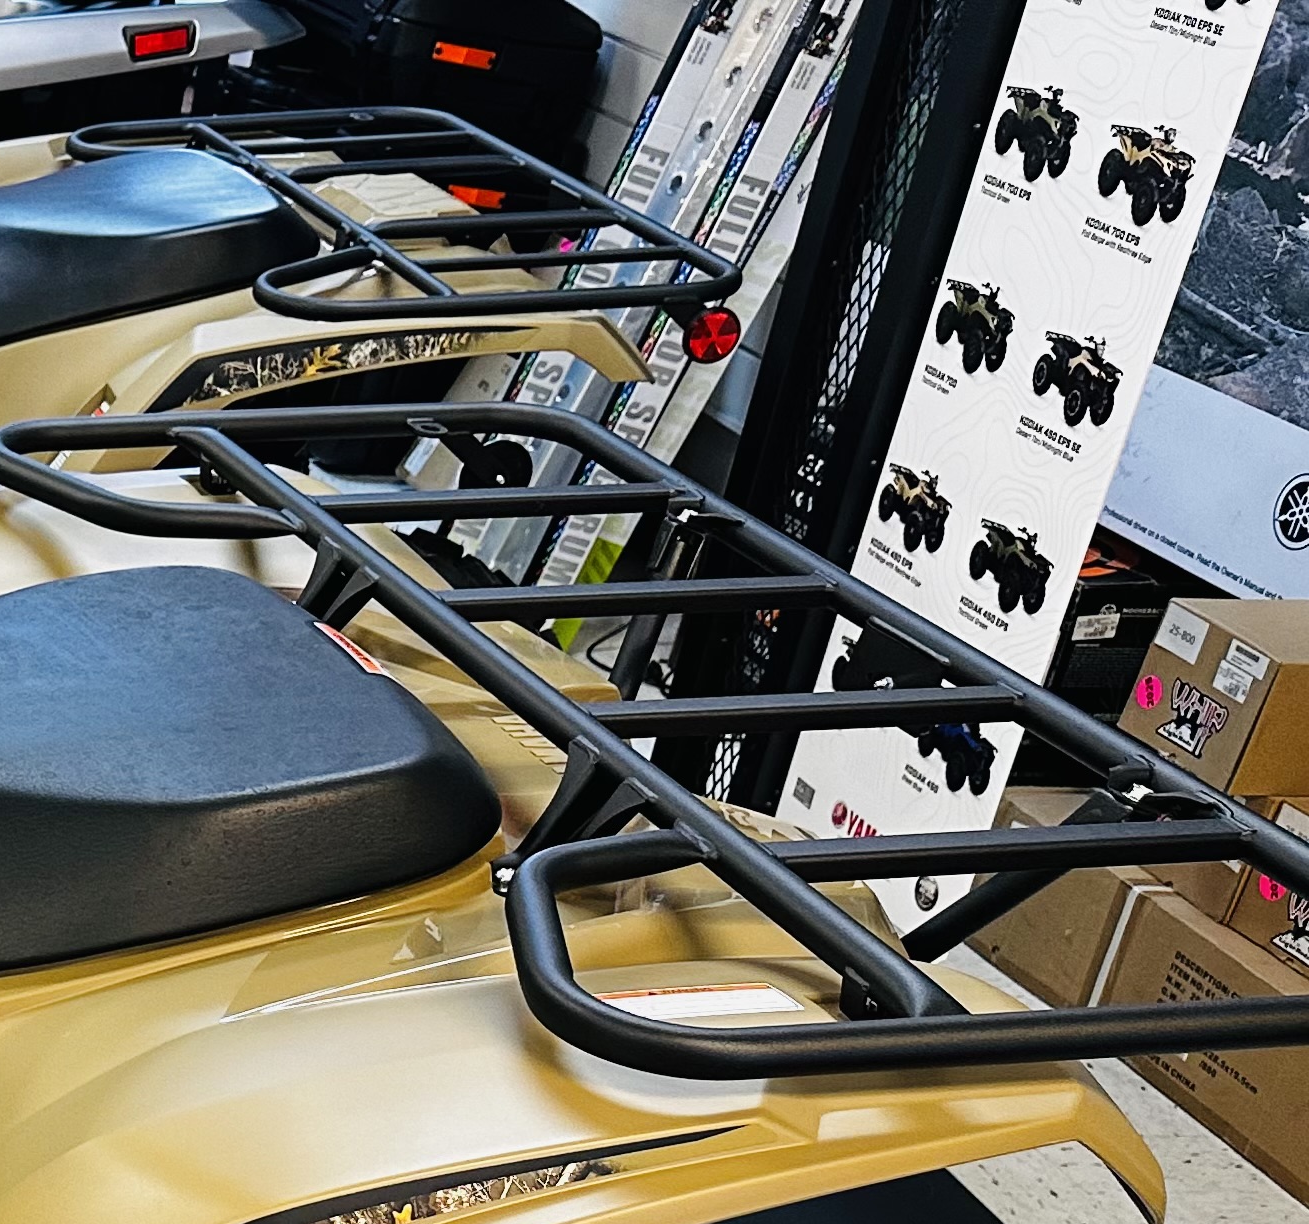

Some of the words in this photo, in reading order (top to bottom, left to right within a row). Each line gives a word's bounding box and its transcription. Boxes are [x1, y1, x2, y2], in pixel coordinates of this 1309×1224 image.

[1154, 7, 1181, 23] KODIAK
[1182, 15, 1197, 28] 700
[1198, 19, 1213, 33] EPS
[1213, 24, 1225, 36] SE
[618, 144, 671, 206] FUL
[984, 174, 1005, 190] KODIAK
[1005, 182, 1019, 196] 700
[1019, 187, 1032, 201] EPS
[708, 174, 771, 255] FULL
[1085, 216, 1110, 235] KODIAK
[1110, 227, 1126, 240] 700
[1126, 233, 1141, 246] EPS
[925, 364, 946, 382] KODIAK
[946, 375, 958, 388] 700
[1020, 415, 1044, 433] KODIAK
[1044, 428, 1057, 441] 450
[1057, 434, 1071, 449] EPS
[1103, 505, 1133, 526] Professional
[1133, 520, 1148, 534] driver
[1147, 529, 1155, 538] on
[1160, 535, 1178, 549] closed
[1196, 553, 1212, 567] Read
[1211, 561, 1221, 572] the
[1221, 566, 1243, 585] Owner's
[1243, 577, 1266, 595] Manual
[1265, 588, 1277, 600] and
[960, 595, 983, 615] KODIAK
[983, 610, 997, 624] 450
[996, 617, 1009, 632] EPS
[1170, 963, 1192, 982] ITEM
[1175, 950, 1232, 996] DESCRIPTION:
